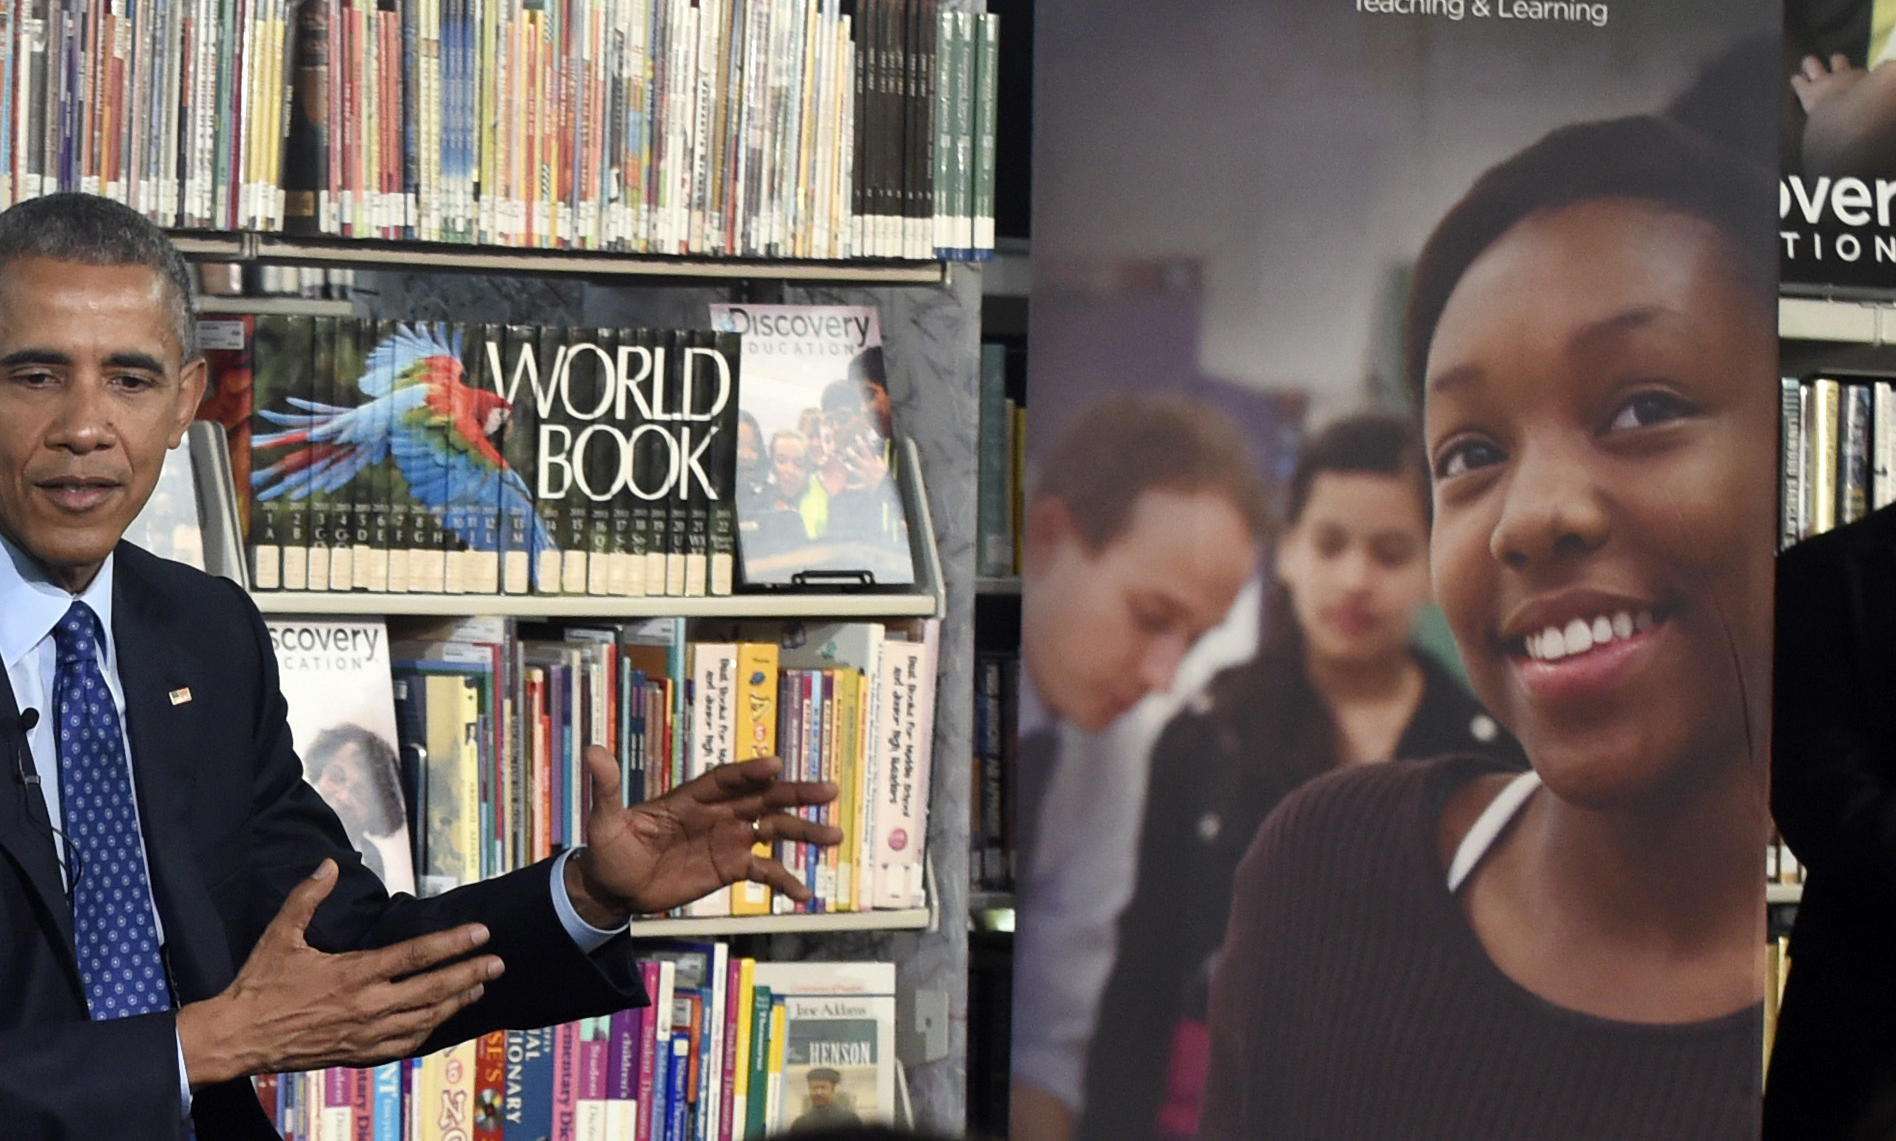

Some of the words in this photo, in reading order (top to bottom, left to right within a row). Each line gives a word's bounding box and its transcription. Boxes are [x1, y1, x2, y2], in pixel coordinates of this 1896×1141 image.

[1471, 1, 1490, 18] &
[1498, 0, 1608, 27] Learning
[729, 307, 870, 347] Discovery
[485, 341, 732, 422] WORLD
[537, 422, 720, 503] BOOK
[264, 528, 275, 540] A
[292, 528, 302, 540] B
[357, 529, 368, 541] D
[377, 530, 385, 542] E
[414, 530, 424, 543] G
[433, 530, 443, 543] H
[267, 627, 379, 662] scovery
[284, 656, 362, 671] CATION
[557, 1025, 573, 1106] ementary
[589, 1044, 603, 1097] Student
[620, 1032, 632, 1098] children's
[809, 1041, 871, 1066] HENSON
[335, 1067, 345, 1103] udent
[506, 1030, 523, 1123] TIONARY
